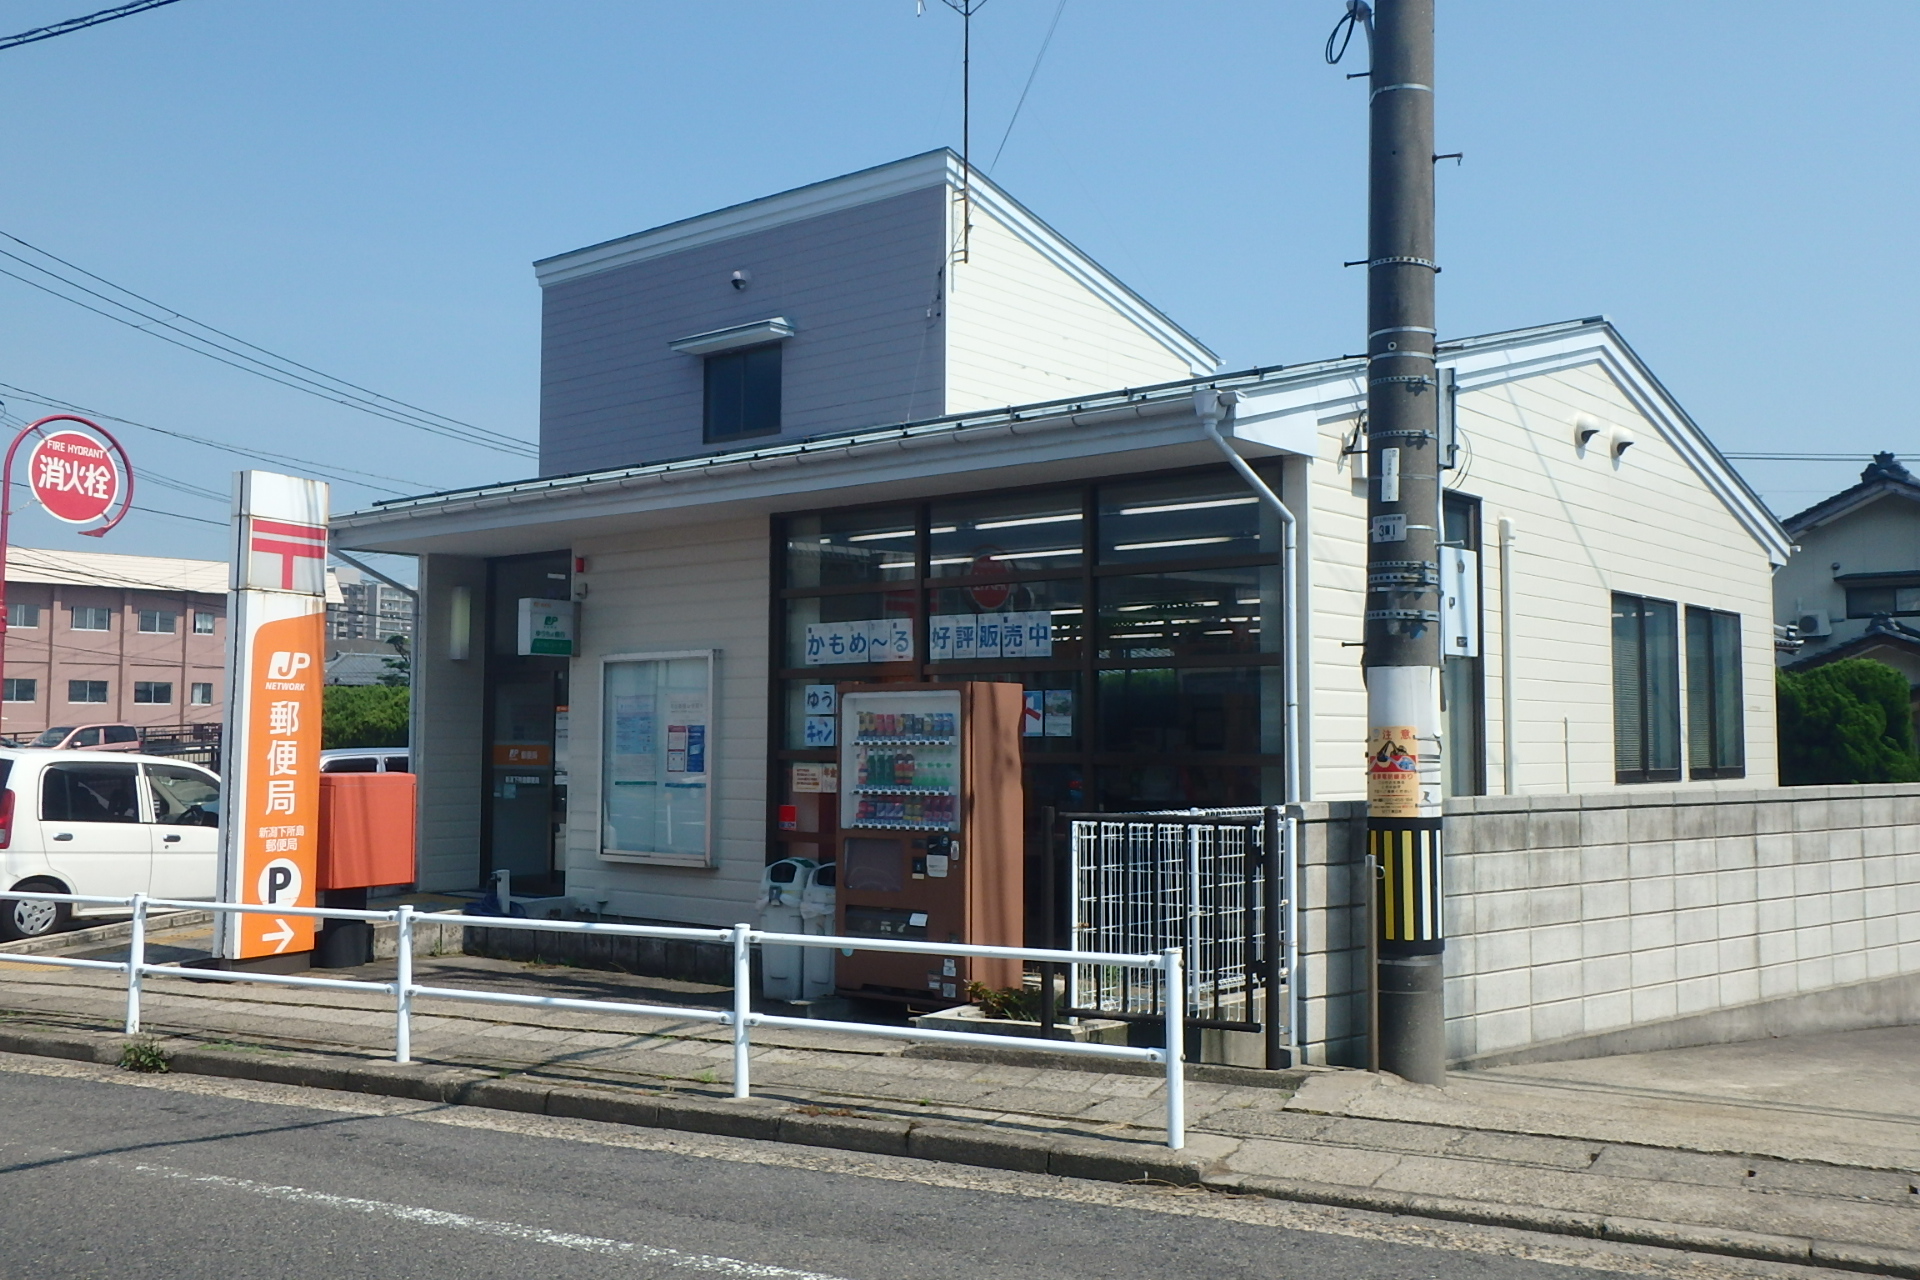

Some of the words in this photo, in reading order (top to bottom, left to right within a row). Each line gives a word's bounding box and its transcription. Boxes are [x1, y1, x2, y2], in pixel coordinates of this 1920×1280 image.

[47, 440, 65, 452] FIRE
[67, 444, 104, 459] HYDRANT
[38, 454, 111, 499] 消火栓
[932, 623, 1049, 649] 好評販売中
[267, 651, 311, 680] JP
[265, 682, 306, 691] NETWORK
[807, 690, 834, 708] ゆう
[1382, 729, 1412, 740] 注意
[265, 700, 301, 816] 郵便局
[264, 838, 298, 852] 郵便局
[268, 866, 292, 904] P
